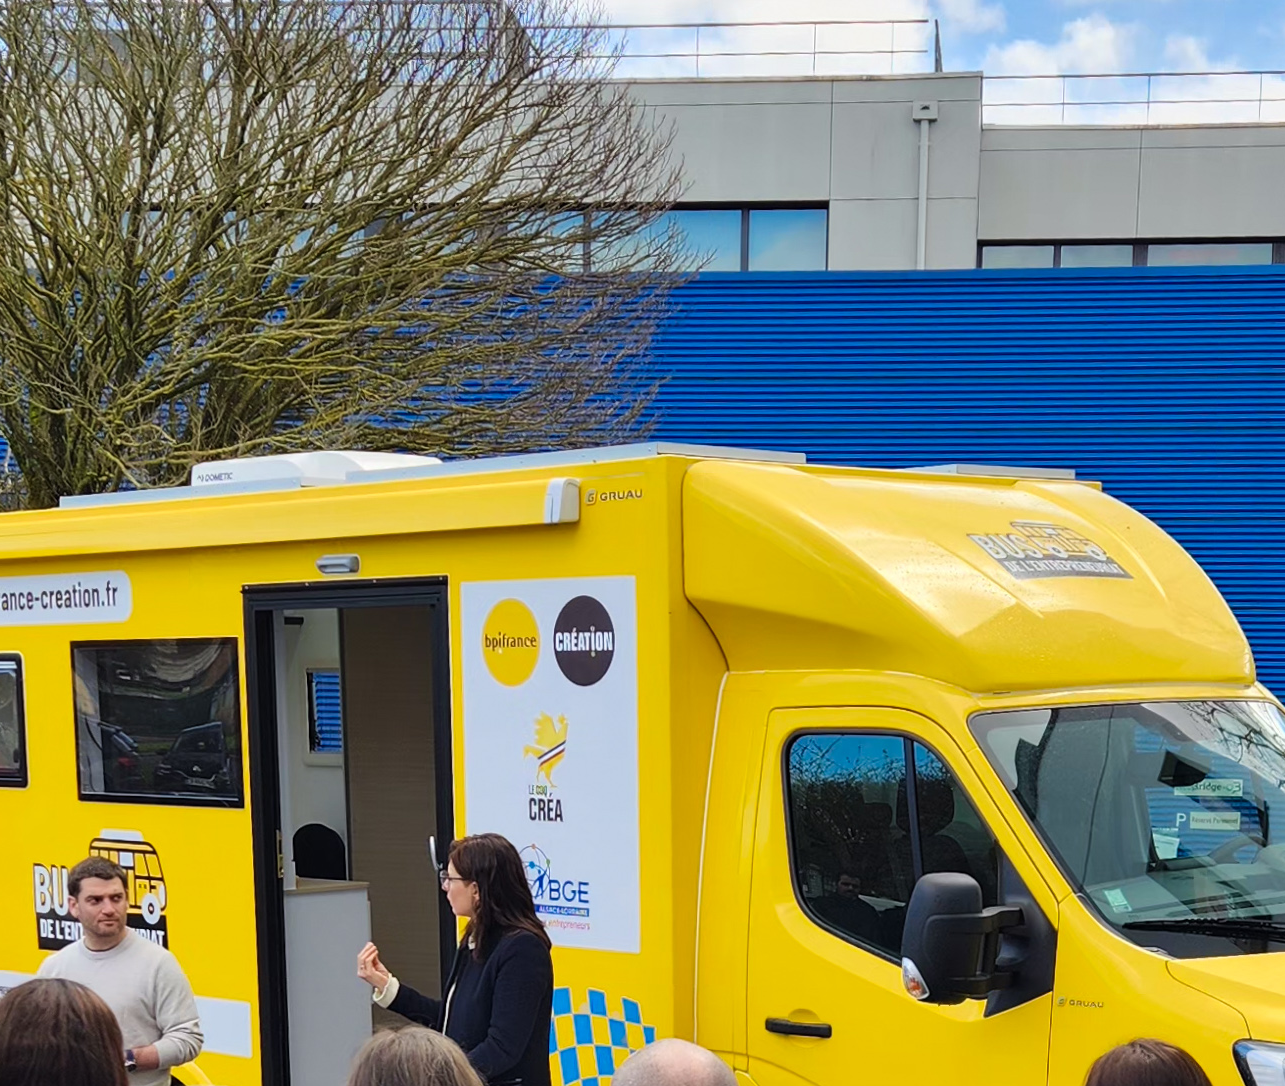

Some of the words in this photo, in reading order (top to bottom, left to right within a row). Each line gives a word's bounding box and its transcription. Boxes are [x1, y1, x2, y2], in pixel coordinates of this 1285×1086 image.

[600, 489, 643, 502] GRUAU
[967, 533, 1044, 559] BUS
[1003, 560, 1024, 572] DE
[484, 632, 537, 652] bpifrance
[528, 793, 563, 822] CRÉA
[33, 864, 70, 916] BU
[549, 879, 590, 903] BGE
[39, 918, 56, 939] DE
[1069, 999, 1104, 1008] GRUAU
